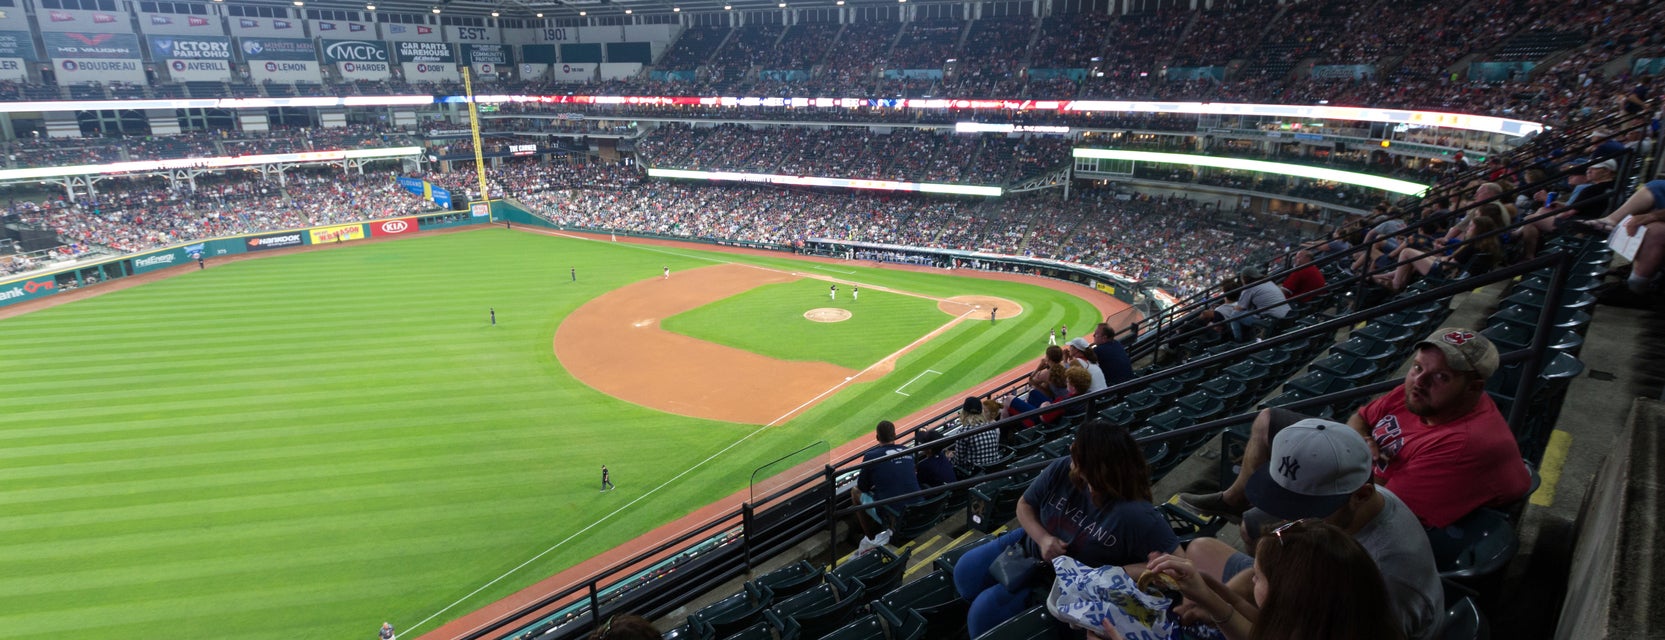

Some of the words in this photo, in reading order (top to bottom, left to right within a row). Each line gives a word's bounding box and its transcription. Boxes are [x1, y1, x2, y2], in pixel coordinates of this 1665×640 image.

[458, 27, 490, 40] EST.
[543, 28, 567, 41] 1901
[173, 50, 202, 58] PARK
[79, 61, 137, 71] BOUDREAU
[187, 62, 226, 71] AVERILL
[277, 63, 306, 71] LEMON
[355, 63, 386, 71] HARDER
[385, 222, 404, 231] KIA
[1048, 492, 1118, 547] LEVELAND
